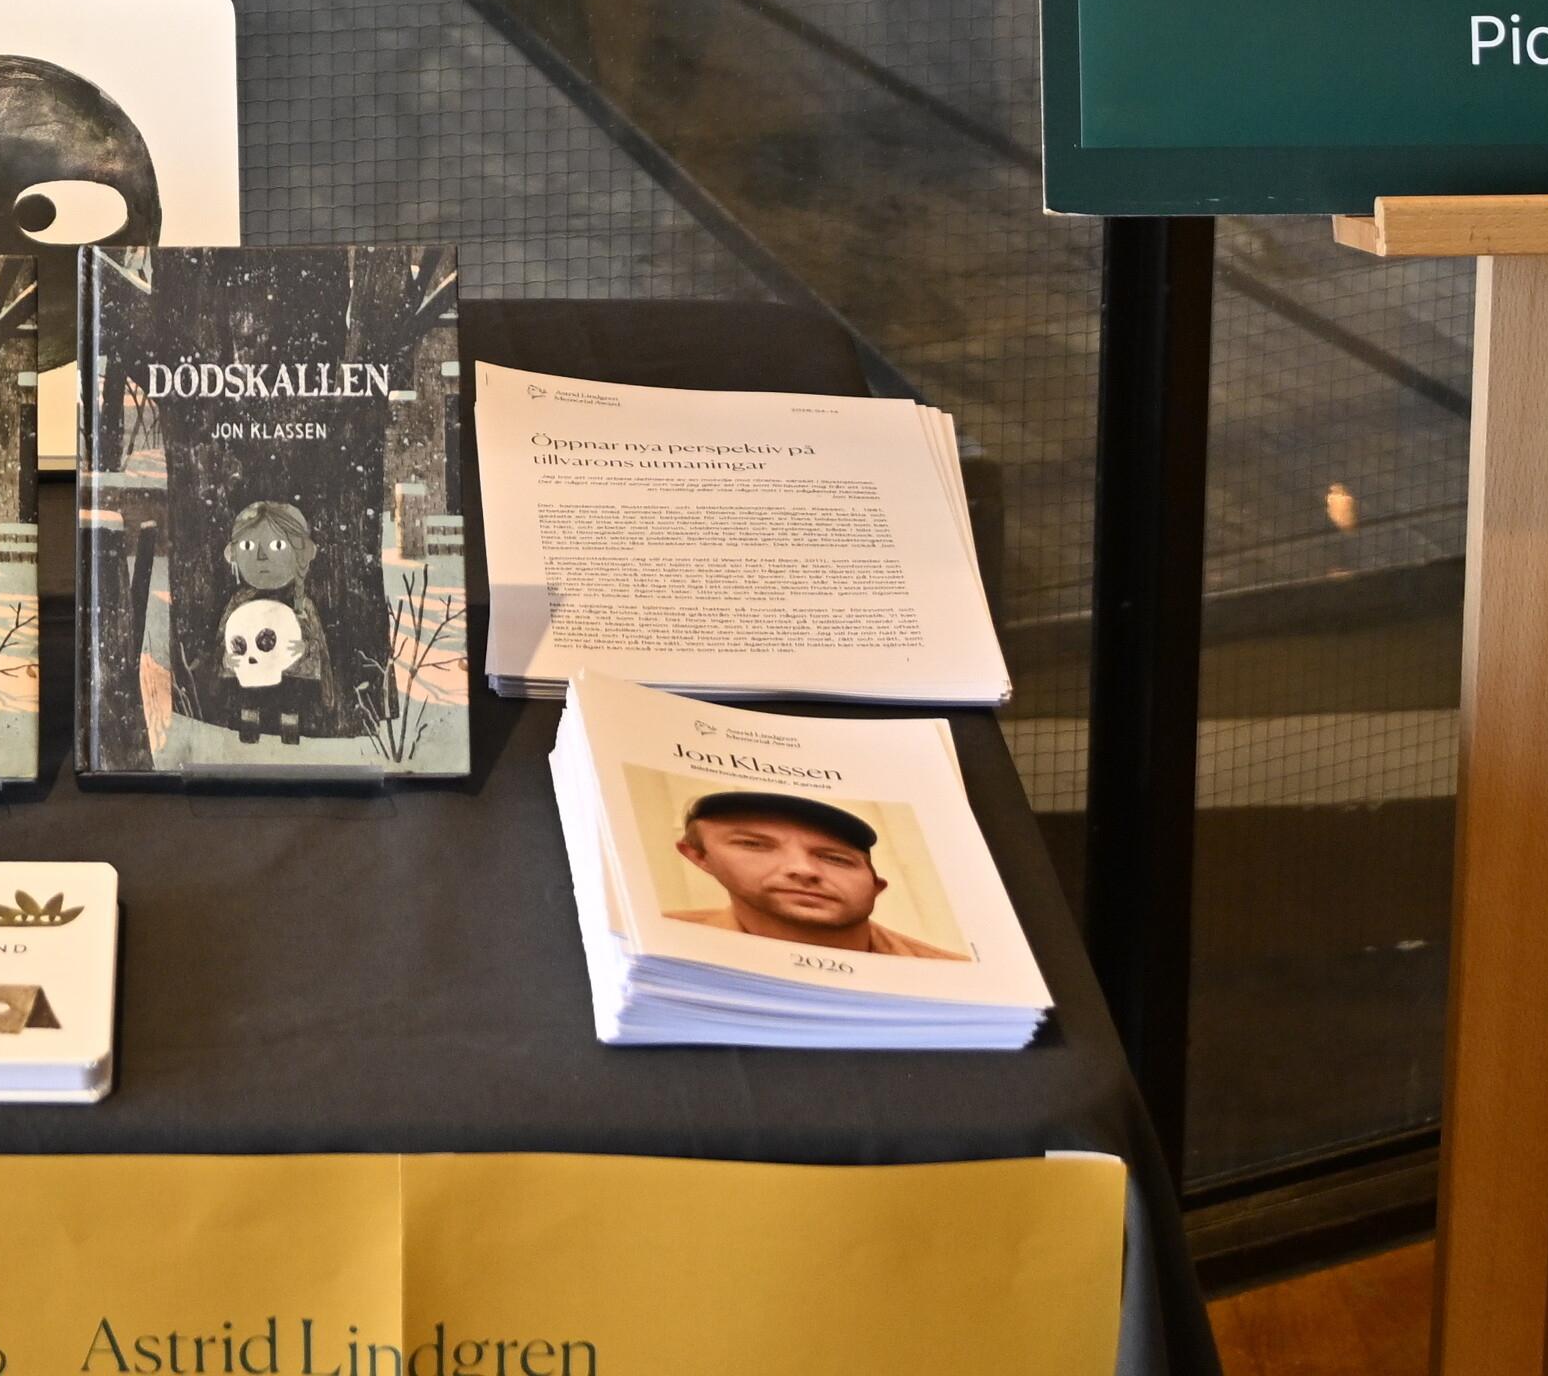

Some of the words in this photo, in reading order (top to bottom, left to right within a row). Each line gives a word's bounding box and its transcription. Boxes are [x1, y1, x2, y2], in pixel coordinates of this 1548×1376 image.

[147, 356, 390, 399] DÖDSKALLEN
[211, 422, 244, 440] JON
[250, 422, 327, 441] KLASSEN
[531, 433, 620, 451] Öppnar
[624, 442, 662, 453] nya
[668, 443, 784, 455] perspektiv
[789, 444, 815, 456] på
[534, 454, 633, 467] tillvarons
[639, 458, 767, 471] utmaningar
[673, 743, 723, 765] Jon
[730, 754, 842, 780] Klassen
[81, 1316, 279, 1375] Astrid
[302, 1319, 598, 1376] Lindgren
